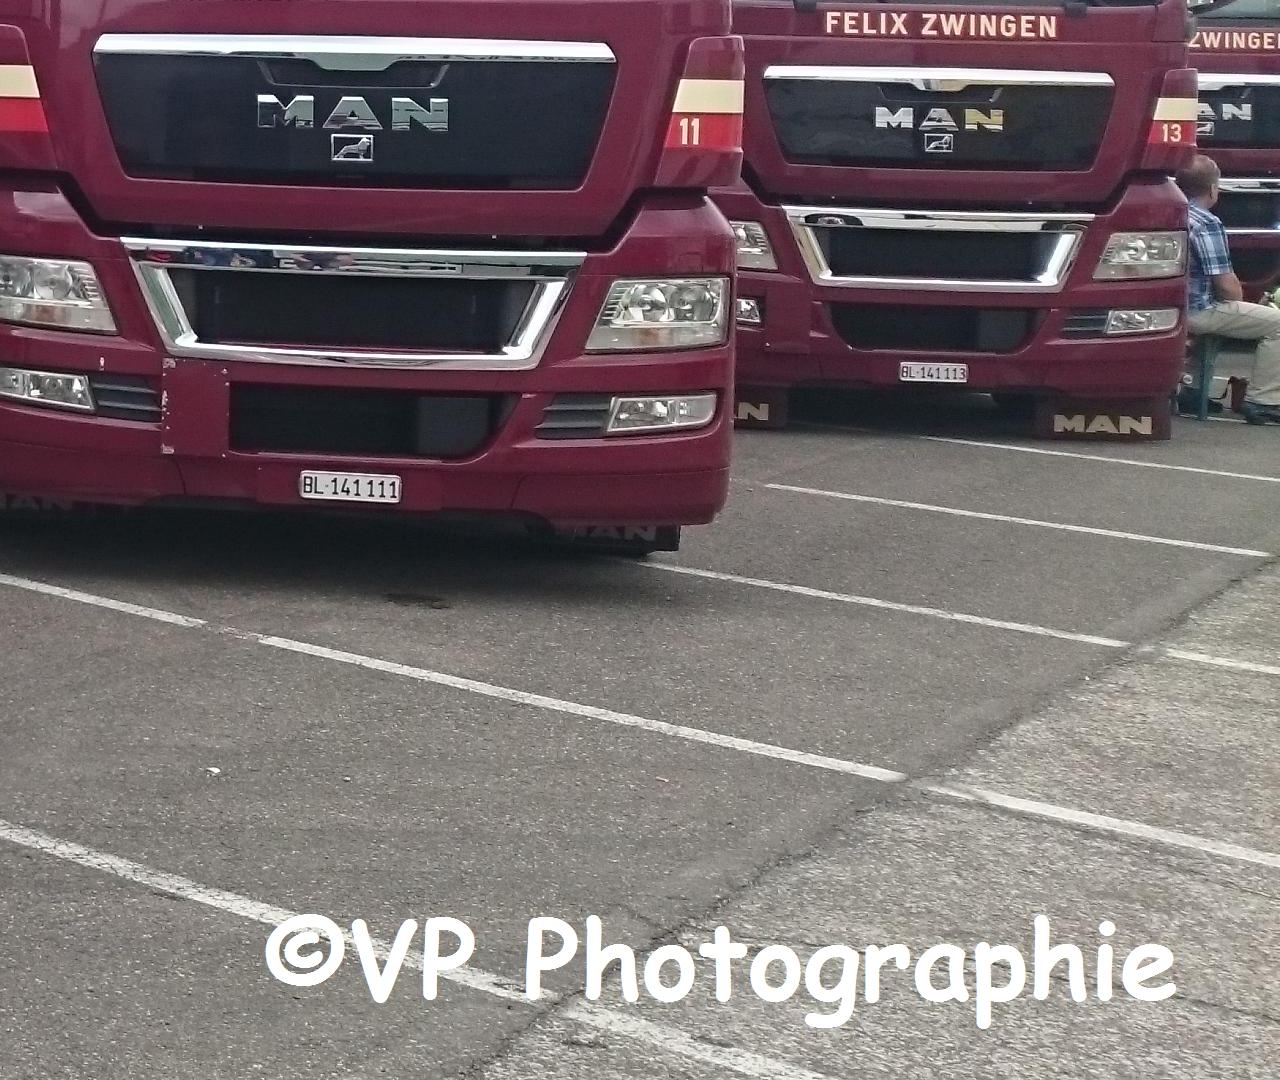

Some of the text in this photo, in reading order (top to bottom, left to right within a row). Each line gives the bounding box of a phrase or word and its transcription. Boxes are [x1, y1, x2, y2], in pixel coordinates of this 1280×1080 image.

[826, 11, 1057, 37] FELIX ZWINGEN
[1188, 32, 1280, 49] ZWINGE
[257, 94, 449, 132] MAN
[875, 106, 1003, 132] MAN
[1198, 103, 1252, 121] AN
[679, 117, 700, 145] 11
[1162, 123, 1182, 142] 13
[1053, 414, 1152, 435] MAN
